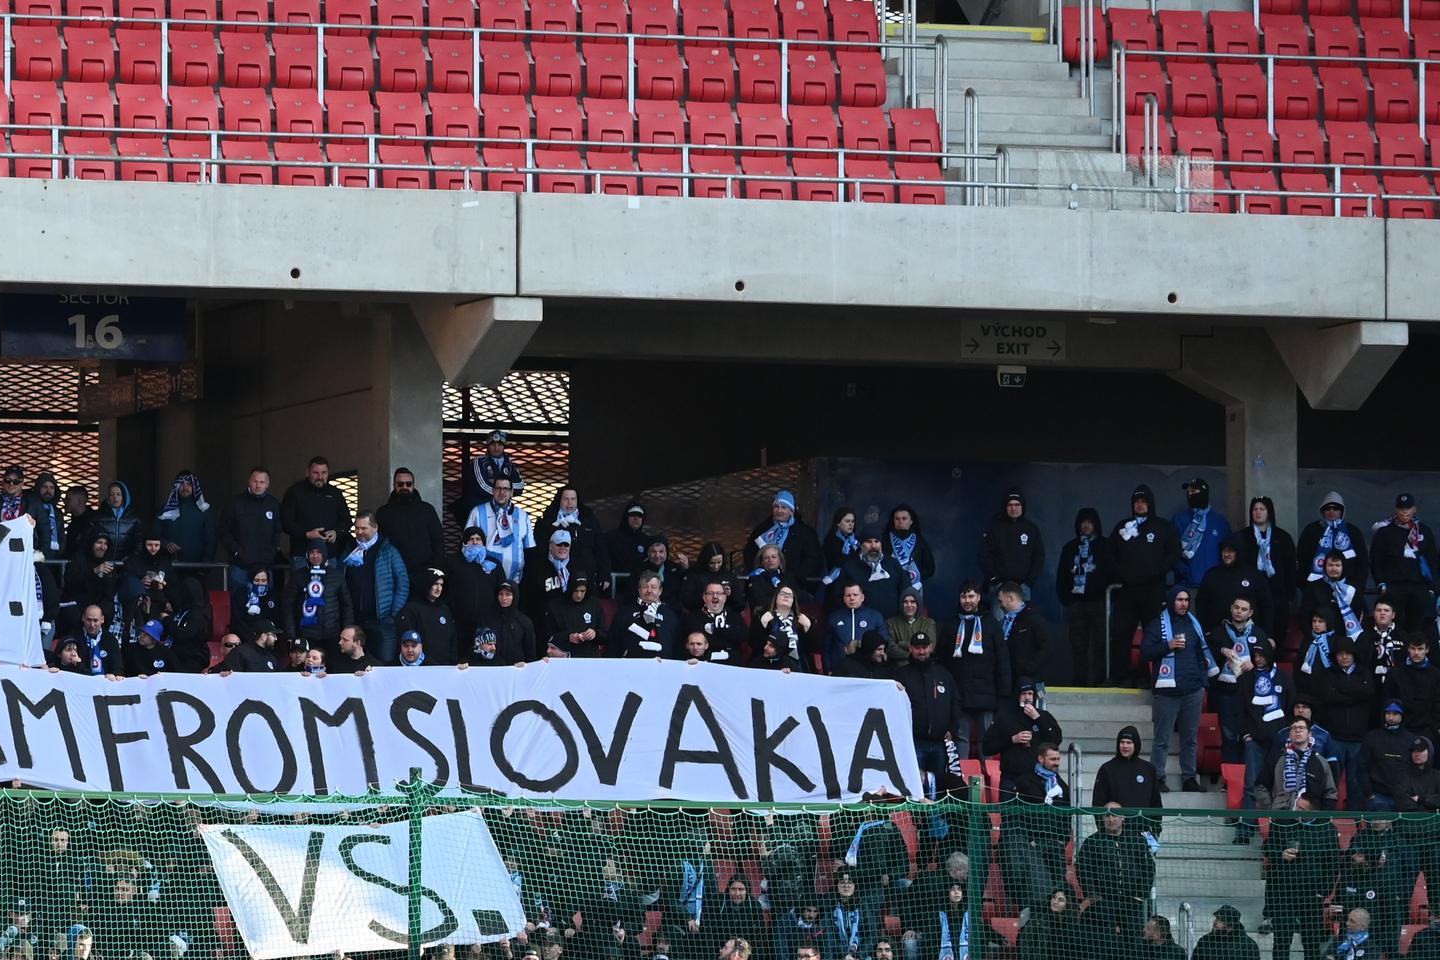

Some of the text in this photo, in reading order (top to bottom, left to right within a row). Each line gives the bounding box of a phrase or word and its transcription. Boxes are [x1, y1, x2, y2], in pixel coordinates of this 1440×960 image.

[67, 314, 125, 349] 16
[980, 322, 1047, 339] VÝCHOD
[996, 342, 1031, 355] EXIT
[98, 687, 379, 794] FROM
[389, 683, 911, 799] SLOVAKIA
[221, 828, 510, 945] VS.
